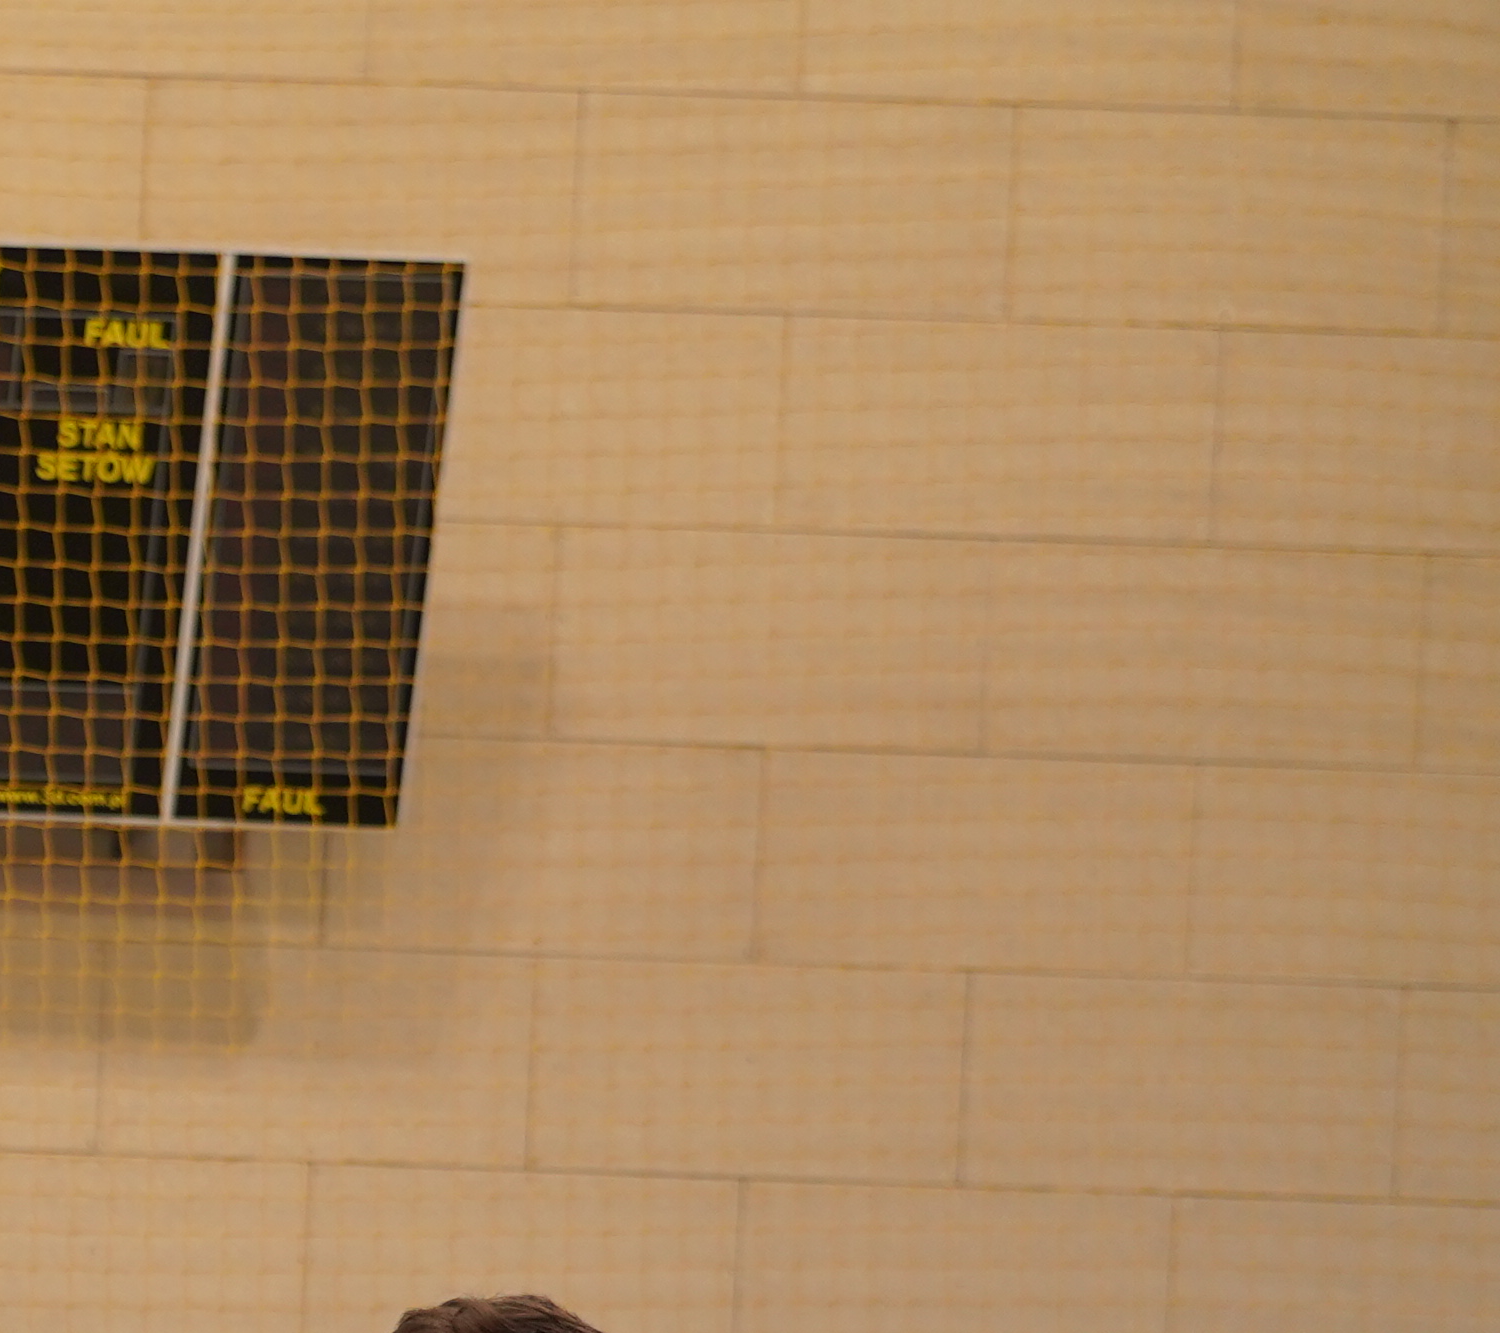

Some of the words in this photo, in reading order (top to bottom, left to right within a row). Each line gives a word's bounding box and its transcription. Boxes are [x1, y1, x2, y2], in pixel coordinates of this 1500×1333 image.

[84, 318, 173, 350] FAUL
[57, 418, 145, 451] STAN
[242, 785, 326, 816] FAUL
